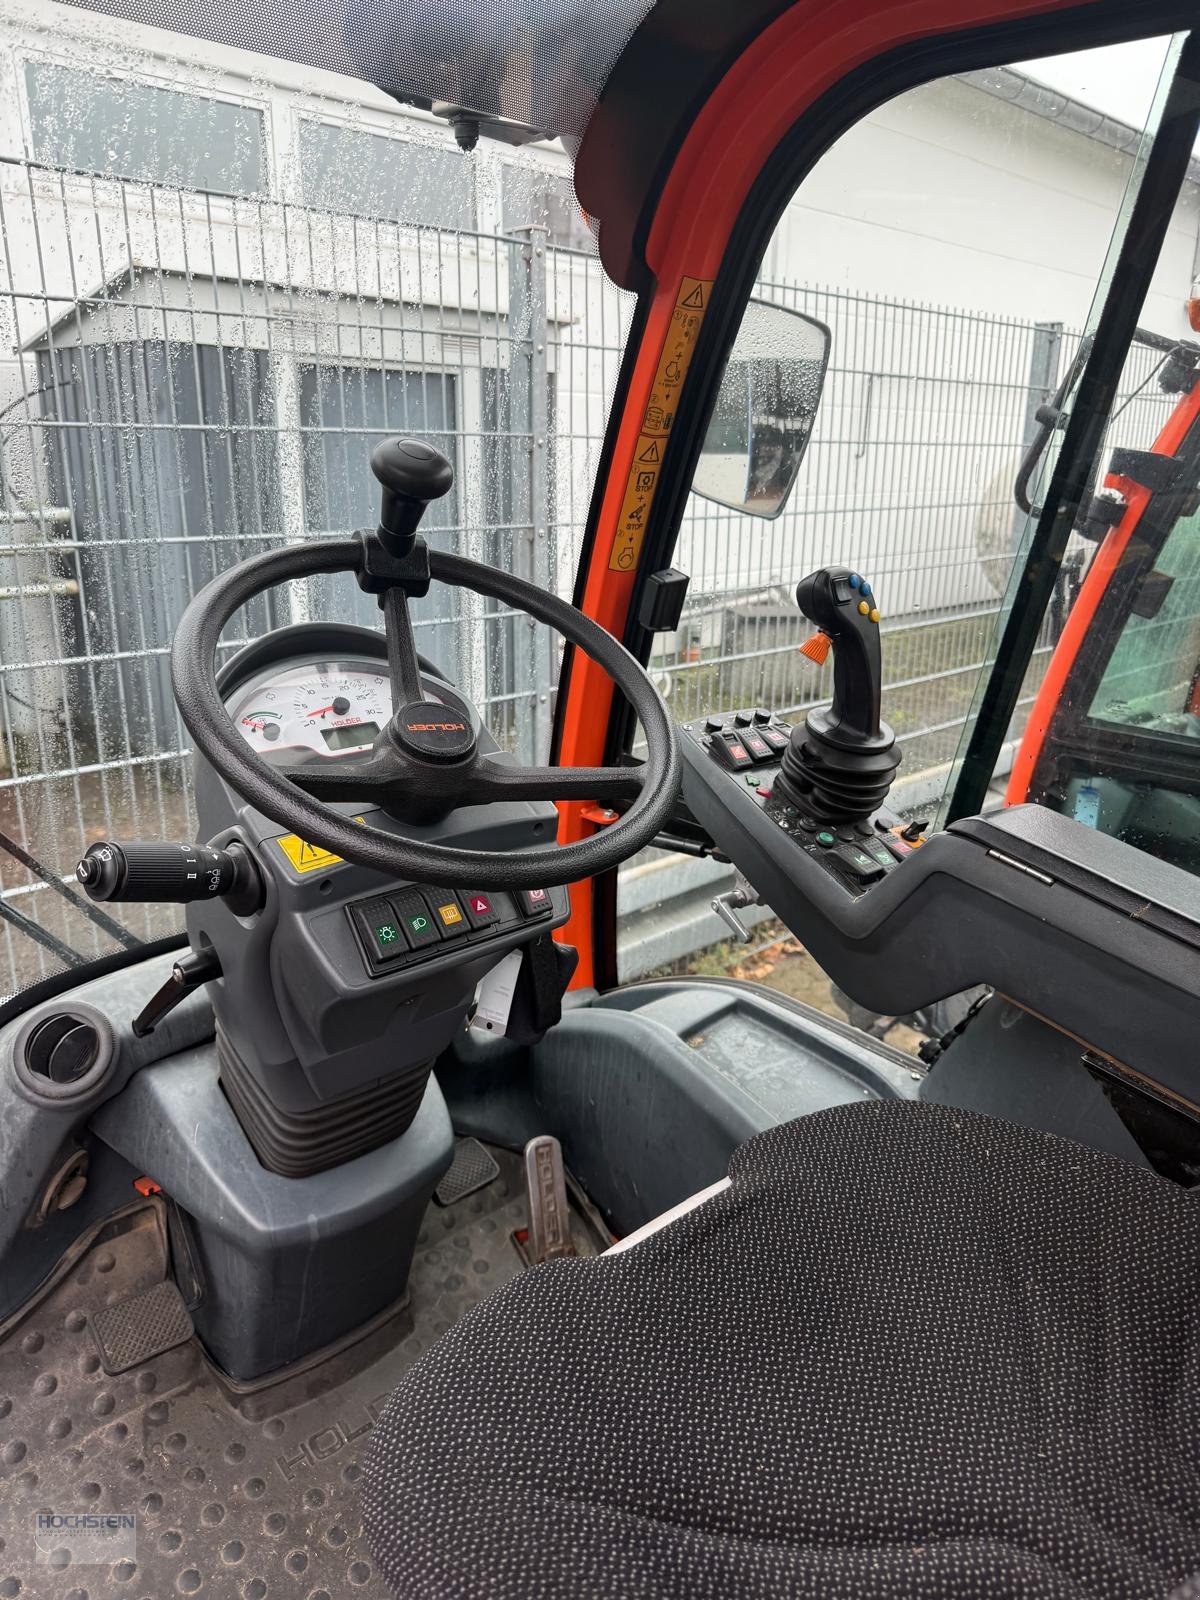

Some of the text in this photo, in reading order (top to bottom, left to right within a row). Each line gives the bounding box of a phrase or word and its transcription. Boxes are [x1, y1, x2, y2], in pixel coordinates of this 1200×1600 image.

[635, 485, 653, 493] STOP
[331, 717, 362, 727] HOLDER
[407, 723, 465, 731] HOLDER
[537, 1146, 561, 1243] HOLDER
